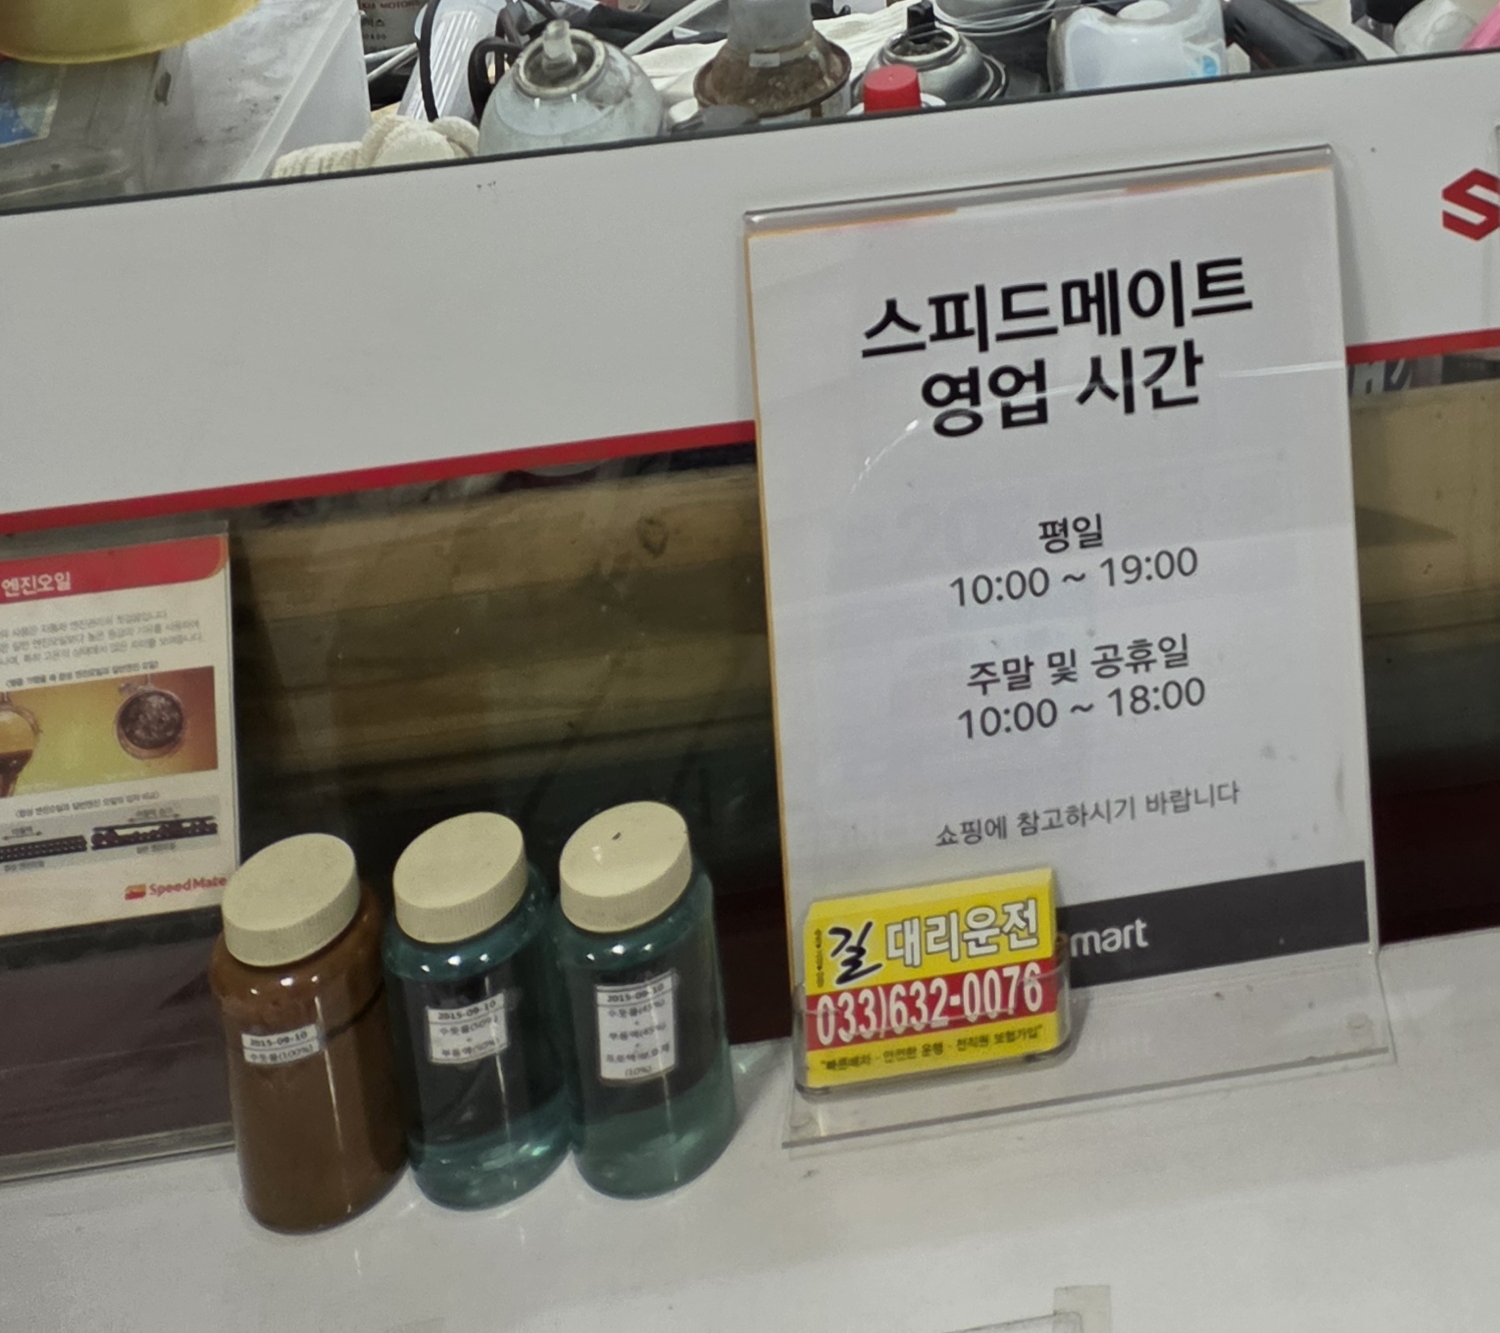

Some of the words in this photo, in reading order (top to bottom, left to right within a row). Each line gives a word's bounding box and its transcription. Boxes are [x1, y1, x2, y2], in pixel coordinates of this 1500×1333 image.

[861, 256, 1253, 359] 스피드메이트
[921, 358, 1049, 438] 영업
[1076, 338, 1204, 415] 시간
[1038, 513, 1103, 554] 평일
[2, 572, 71, 597] 엔진오일
[949, 565, 1050, 608] 10:00
[1100, 546, 1198, 588] 19:00
[967, 655, 1035, 696] 주말
[1047, 648, 1079, 687] 및
[1090, 633, 1190, 680] 공휴일
[957, 698, 1058, 740] 10:00
[1107, 677, 1206, 718] 18:00
[935, 814, 1008, 847] 쇼핑에
[1016, 795, 1136, 838] 참고하시기
[1145, 780, 1240, 817] 바랍니다
[149, 875, 228, 897] SpeedMate
[828, 921, 883, 985] 길
[885, 898, 1039, 968] 대리운전
[1057, 917, 1149, 959] mart
[816, 961, 1044, 1046] 033)632-0076
